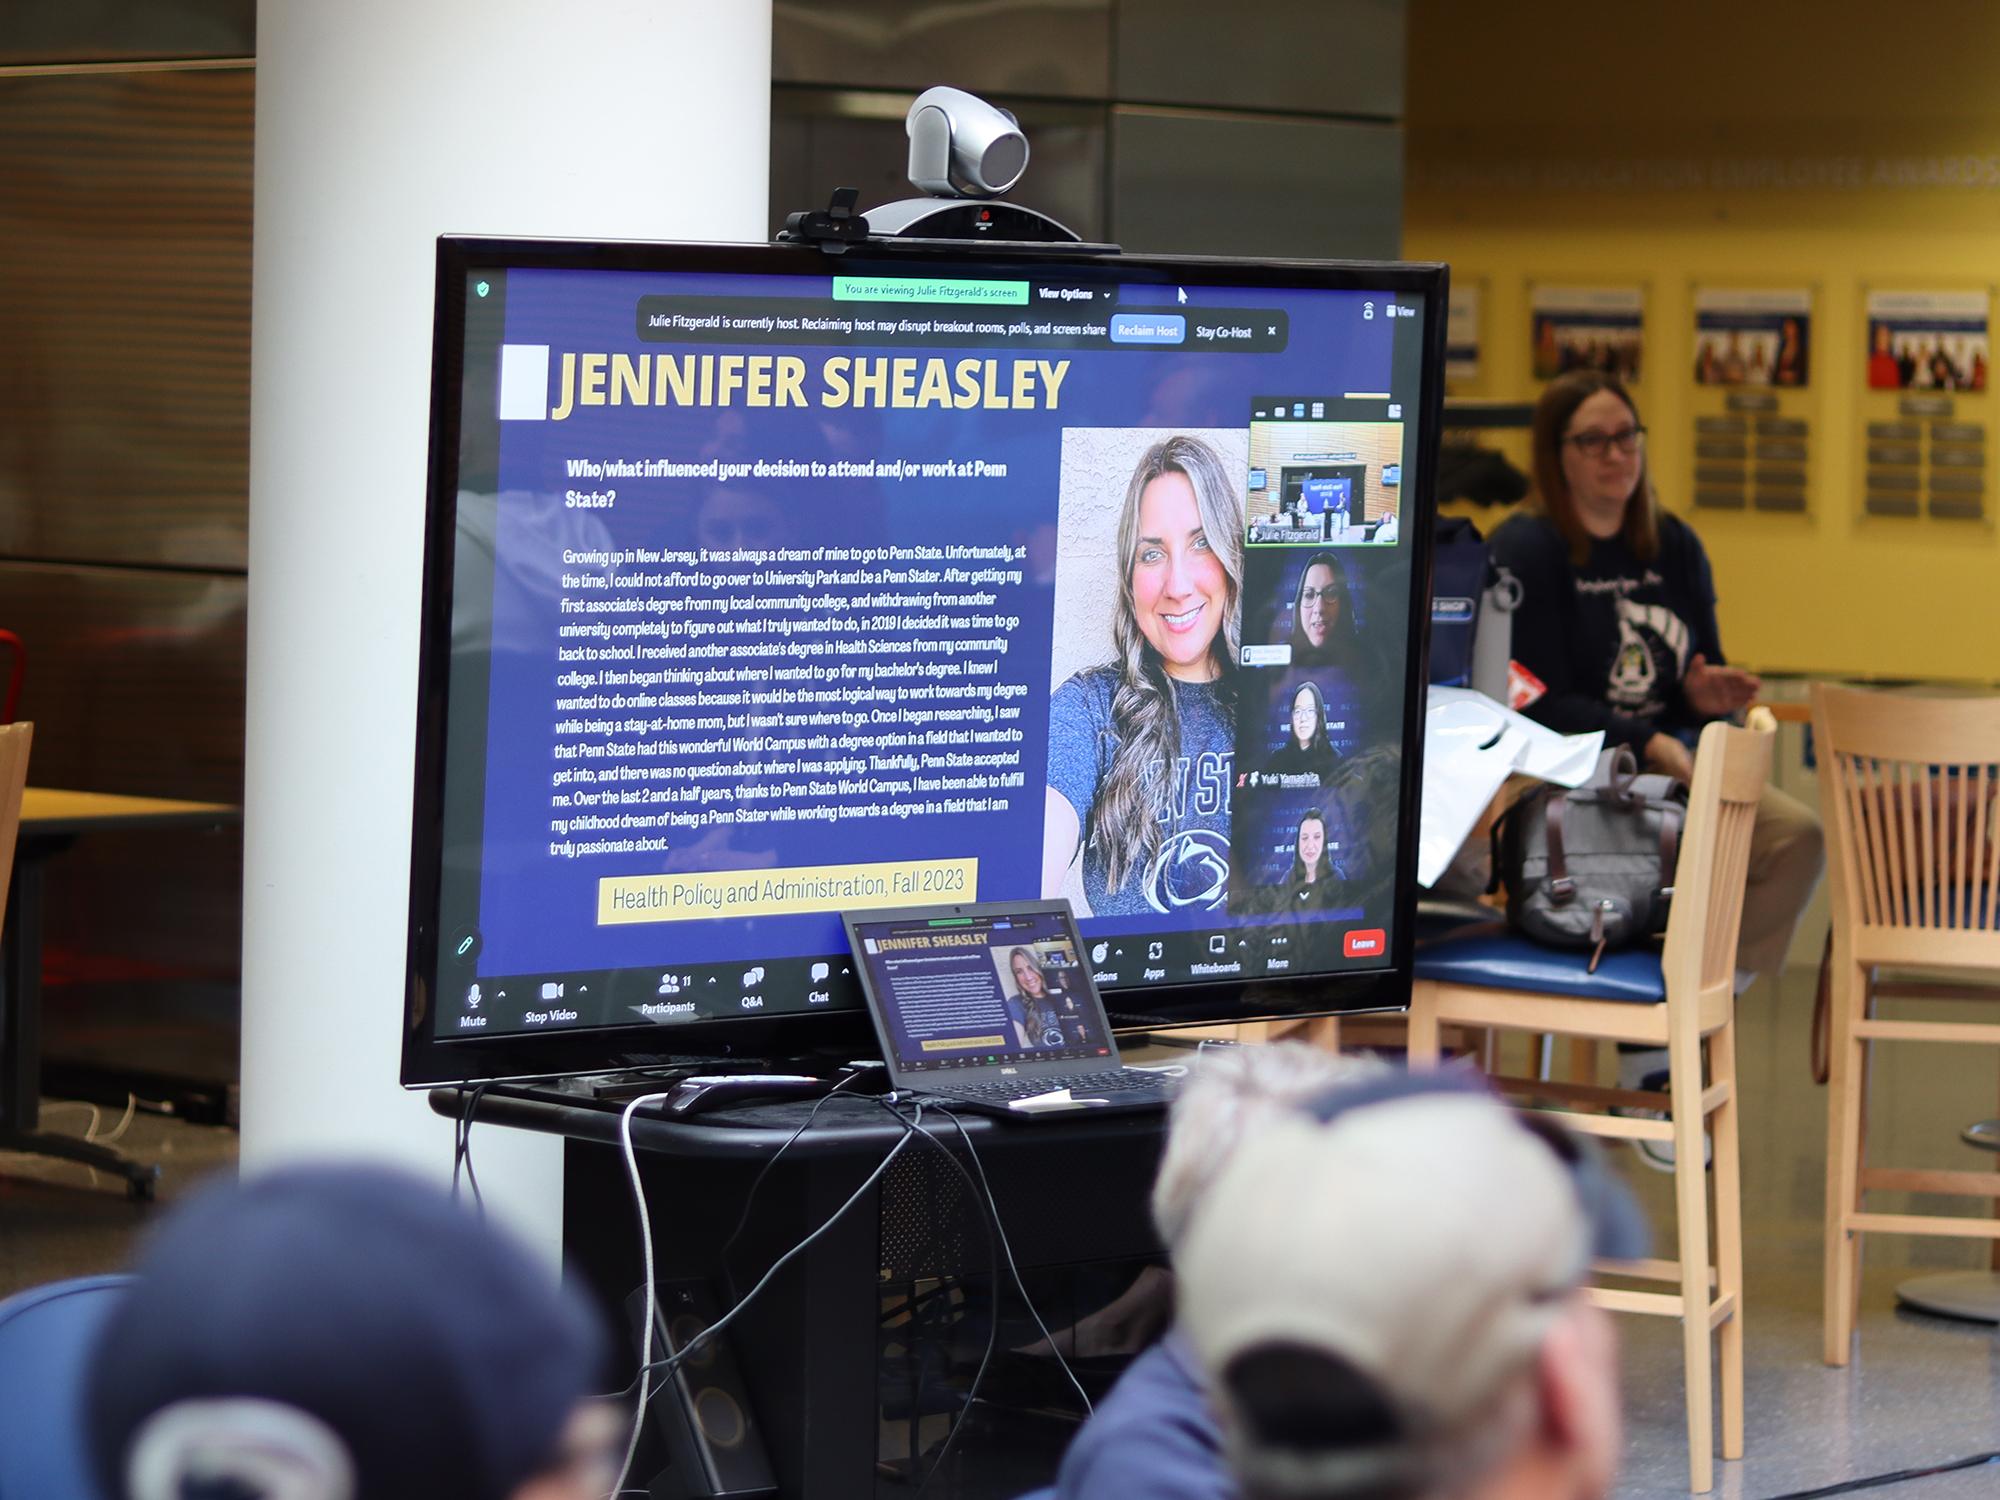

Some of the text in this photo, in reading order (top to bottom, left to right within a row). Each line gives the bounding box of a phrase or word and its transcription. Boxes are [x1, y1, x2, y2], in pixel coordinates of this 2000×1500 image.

[845, 284, 862, 294] You
[881, 285, 915, 297] viewing
[917, 286, 937, 296] Julie
[939, 286, 988, 299] Fitzgerald's
[990, 289, 1018, 297] screen
[1038, 287, 1093, 301] View Options
[1397, 307, 1415, 316] View
[648, 314, 1106, 336] Julie Fitzgerald is currently host. Reclaiming host may disrupt breakout rooms, polls, and screen share
[1117, 323, 1178, 336] Reclaim Host
[1196, 325, 1252, 340] Stay Co-Host
[550, 354, 1070, 420] JENNIFER SHEASLEY
[566, 458, 1006, 481] Who/what influenced your decision to attend and/or work at Penn
[564, 489, 616, 508] State?
[1282, 530, 1318, 541] Fitzgerald
[563, 544, 1026, 568] Growing up in New Jersey, it was always a dream of mine to go to Penn State. Unfortunately, at
[561, 567, 1022, 590] the time, I could not afford to go over to University Park and be a Penn Stater. After getting my
[559, 590, 996, 615] first associate's degree from my local community college, and withdrawing from another
[1262, 774, 1278, 784] Yuki
[550, 796, 1008, 835] my childhood dream of being a Penn Stater while working towards a degree in a field that I am
[549, 835, 668, 858] truly passionate about.
[613, 868, 963, 909] Health Policy and Administration, Fall 2023
[878, 933, 987, 953] JENNIFER SHEASLEY
[1353, 939, 1374, 949] Leave
[1191, 961, 1240, 974] Whiteboards
[1268, 959, 1288, 968] More
[683, 976, 690, 986] 11
[1144, 968, 1164, 980] Apps
[742, 996, 763, 1008] Q&A
[809, 991, 829, 1002] Chat
[642, 1001, 695, 1014] Participants
[461, 1014, 486, 1027] Mute
[526, 1009, 577, 1024] Stop Video
